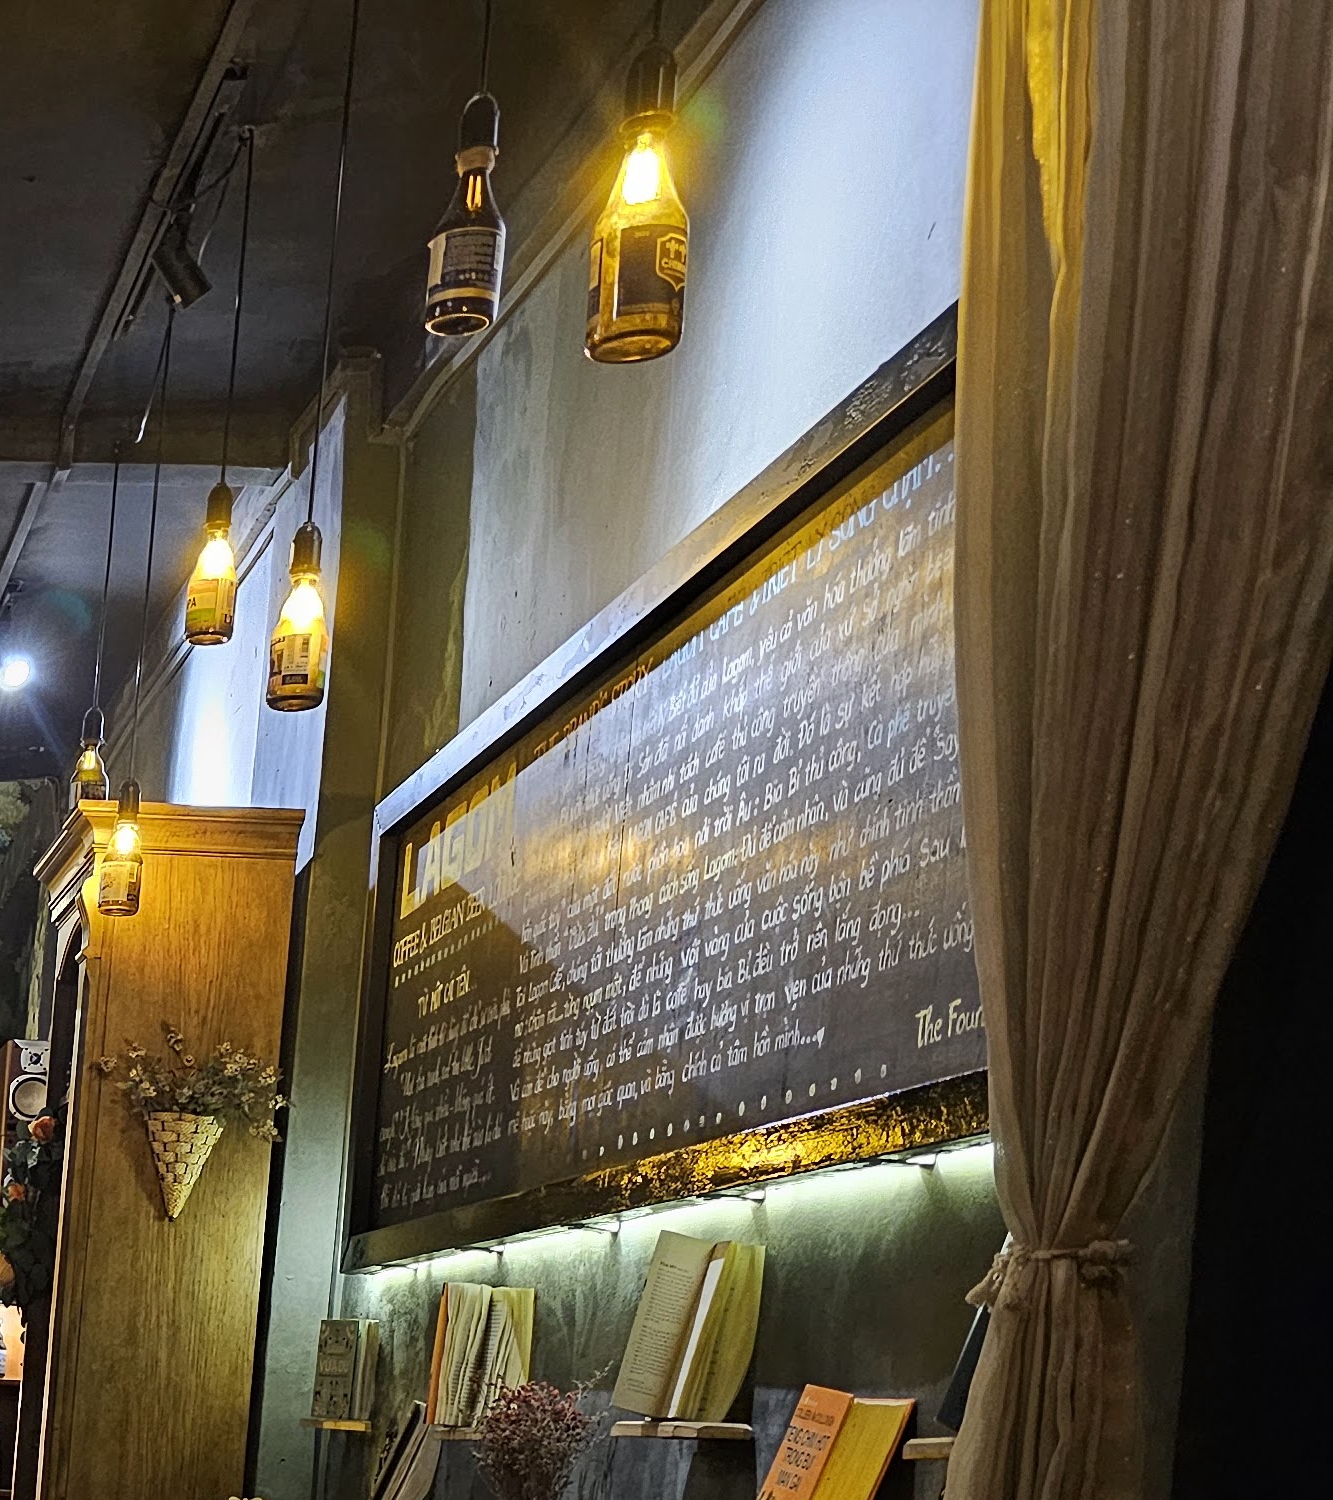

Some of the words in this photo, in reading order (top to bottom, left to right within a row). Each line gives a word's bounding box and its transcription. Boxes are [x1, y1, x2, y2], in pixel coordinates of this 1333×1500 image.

[399, 760, 517, 921] LAGOM
[429, 899, 466, 946] BELGIAN
[915, 1005, 941, 1047] The
